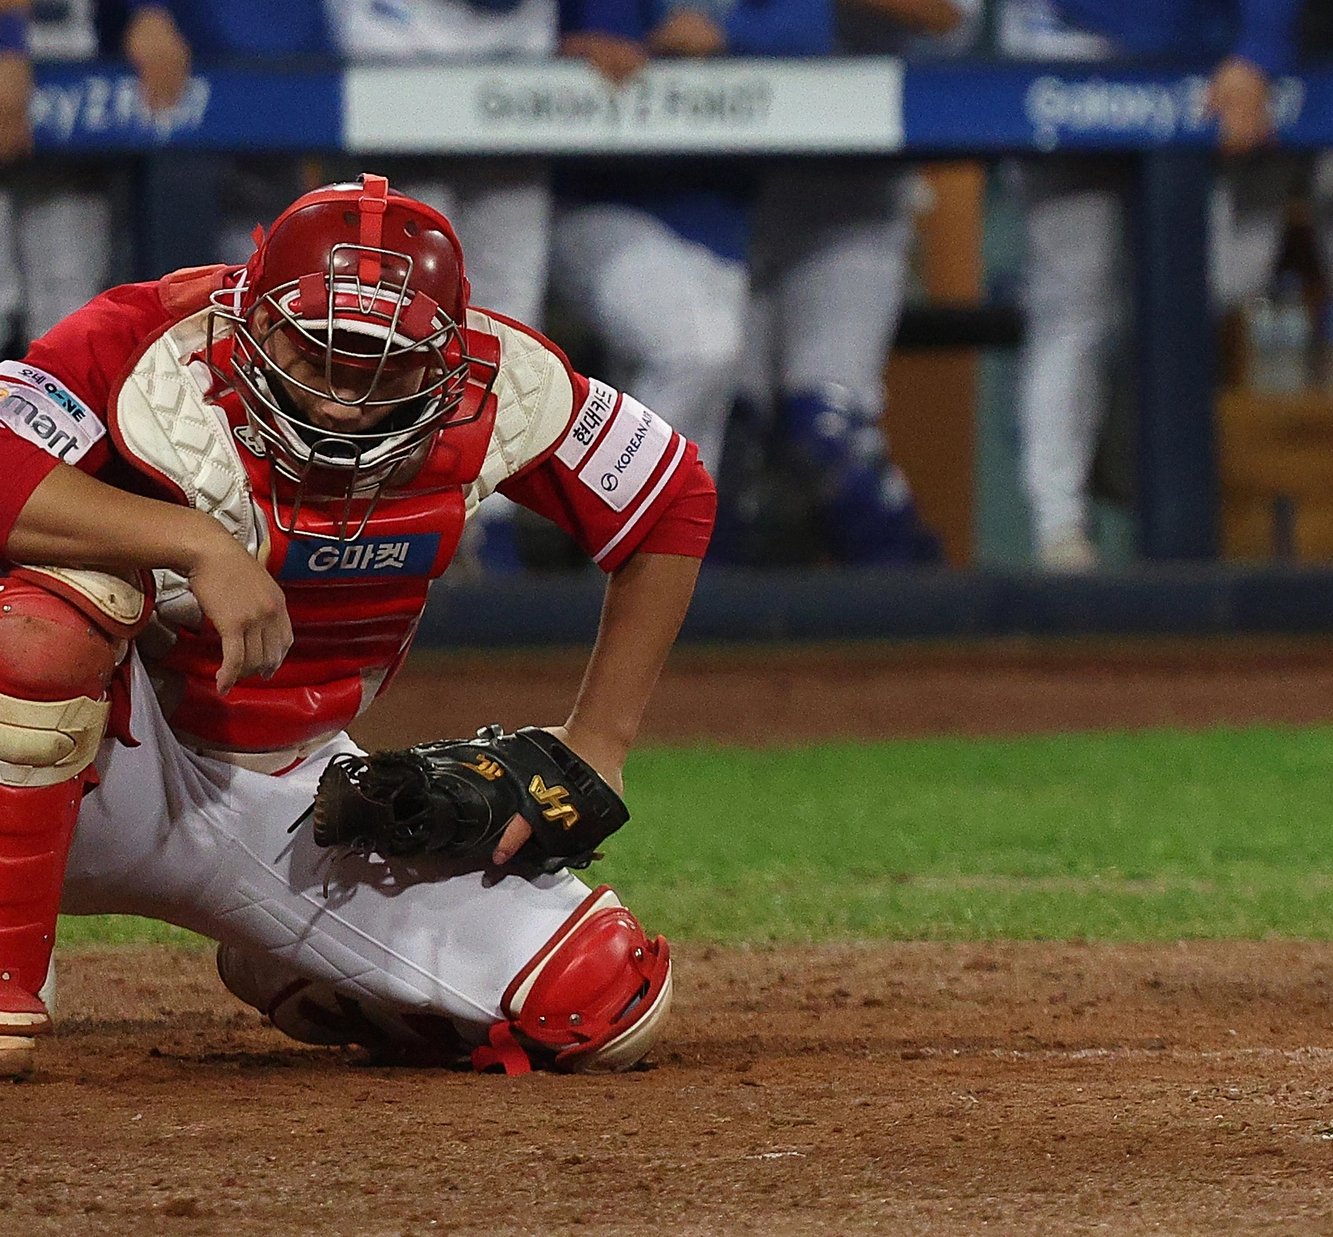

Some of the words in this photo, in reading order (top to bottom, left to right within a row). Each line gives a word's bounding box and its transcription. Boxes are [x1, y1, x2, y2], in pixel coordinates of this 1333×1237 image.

[572, 387, 612, 446] 현대카드
[613, 425, 648, 474] KOREAN
[641, 410, 653, 428] AIR
[307, 541, 411, 572] G마켓
